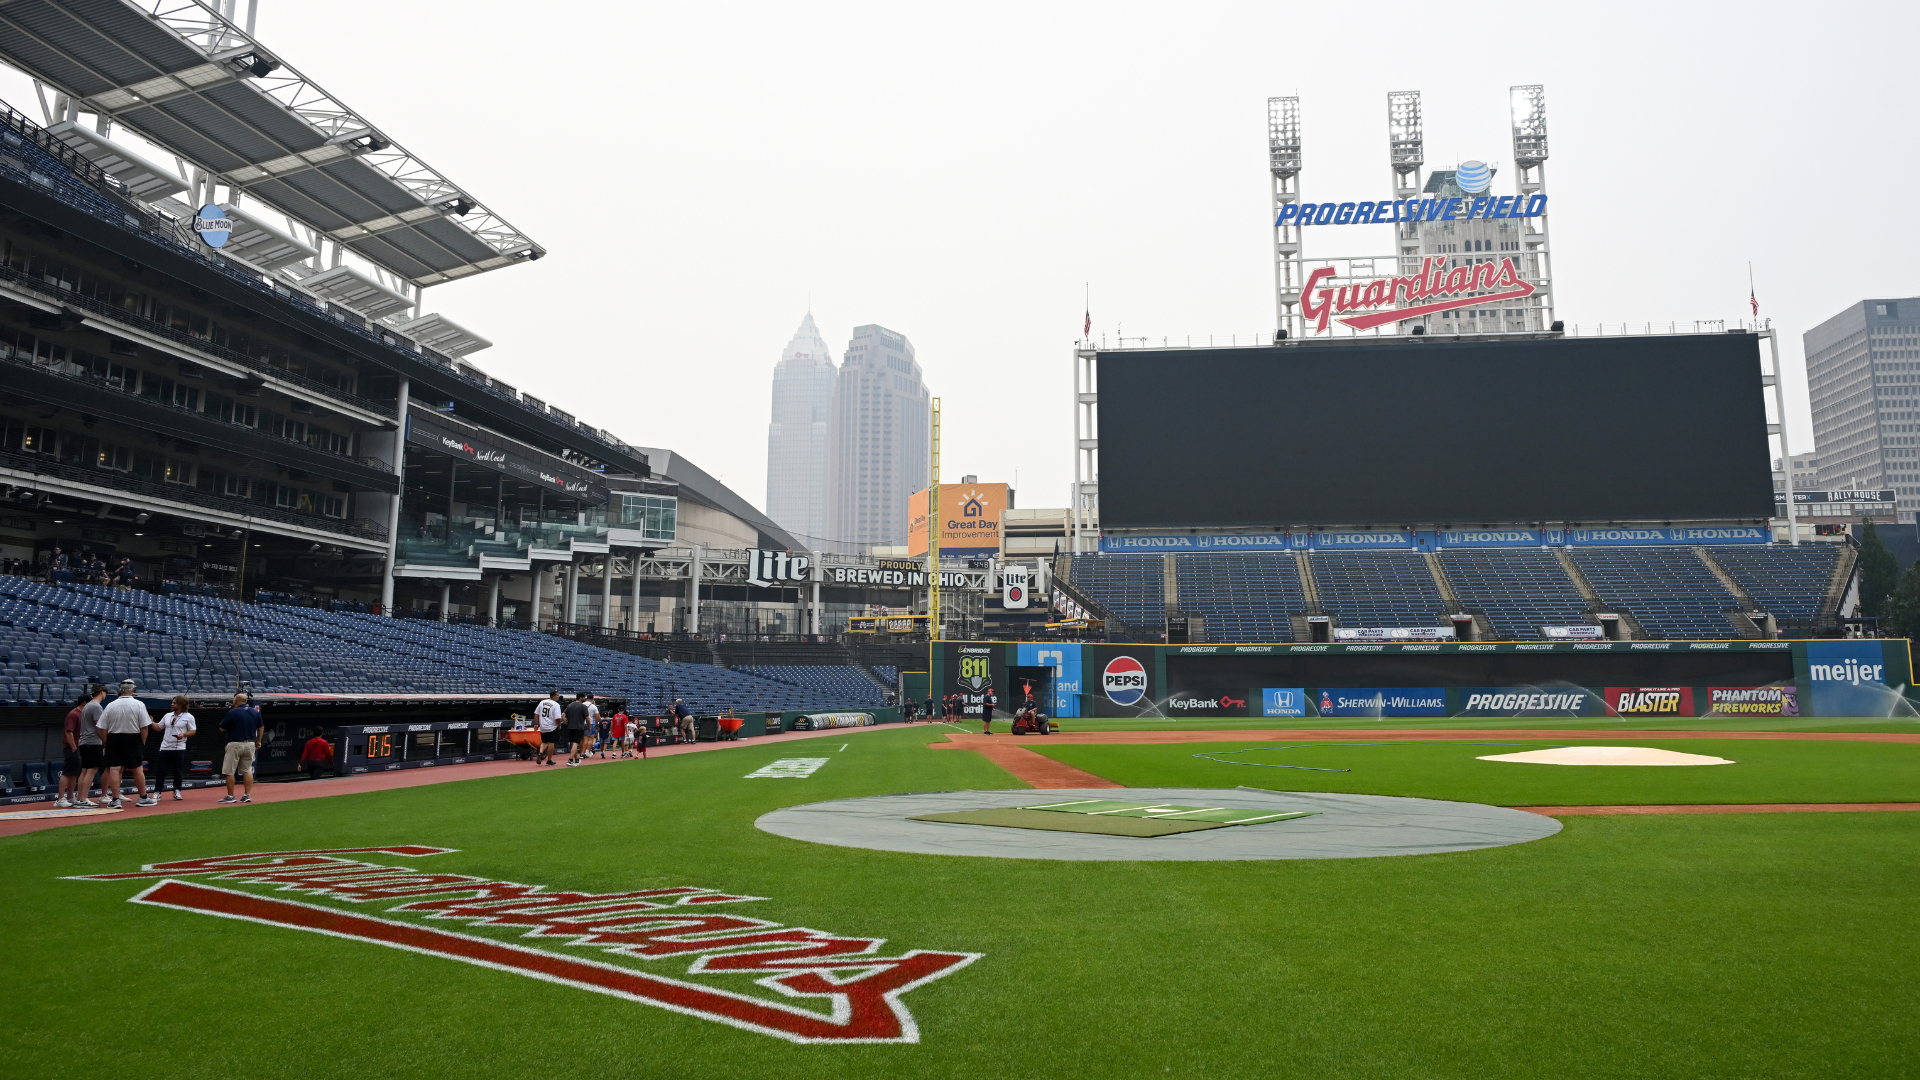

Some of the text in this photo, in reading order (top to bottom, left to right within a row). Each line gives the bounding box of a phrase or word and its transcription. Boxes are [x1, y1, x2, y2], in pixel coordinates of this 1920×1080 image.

[1275, 197, 1462, 227] PROGRESSIVE
[1466, 194, 1548, 219] FIELD
[214, 220, 232, 229] MOON
[1300, 255, 1537, 336] Guardians
[442, 436, 464, 451] KeyBank
[539, 472, 556, 484] KeyBank
[1827, 491, 1852, 502] RALLY
[1854, 491, 1881, 501] HOUSE
[947, 519, 998, 530] Great Day
[942, 530, 999, 539] Improvement
[1336, 533, 1406, 544] HONDA
[1462, 531, 1535, 542] HONDA
[1591, 529, 1665, 540] HONDA
[1687, 528, 1762, 539] HONDA
[1123, 537, 1191, 547] HONDA
[1213, 535, 1282, 546] HONDA
[745, 548, 808, 588] Lite
[880, 560, 923, 571] PROUDLY
[835, 569, 904, 585] BREWED
[907, 572, 924, 586] IN
[1005, 573, 1026, 586] Lite
[961, 657, 987, 678] 811
[1810, 658, 1882, 686] meijer
[1105, 675, 1144, 686] PEPSI
[970, 694, 997, 703] befe
[1712, 689, 1781, 702] PHANTOM
[1169, 698, 1218, 710] KeyBank
[1466, 694, 1585, 710] PROGRESSIVE
[1617, 692, 1680, 713] BLASTER
[541, 707, 550, 718] 91
[1712, 703, 1781, 714] FIREWORKS
[362, 725, 390, 733] PROGRESSIVE
[447, 722, 469, 730] PROGRESSIVE
[368, 734, 391, 758] 0:15
[270, 749, 287, 758] Clinic
